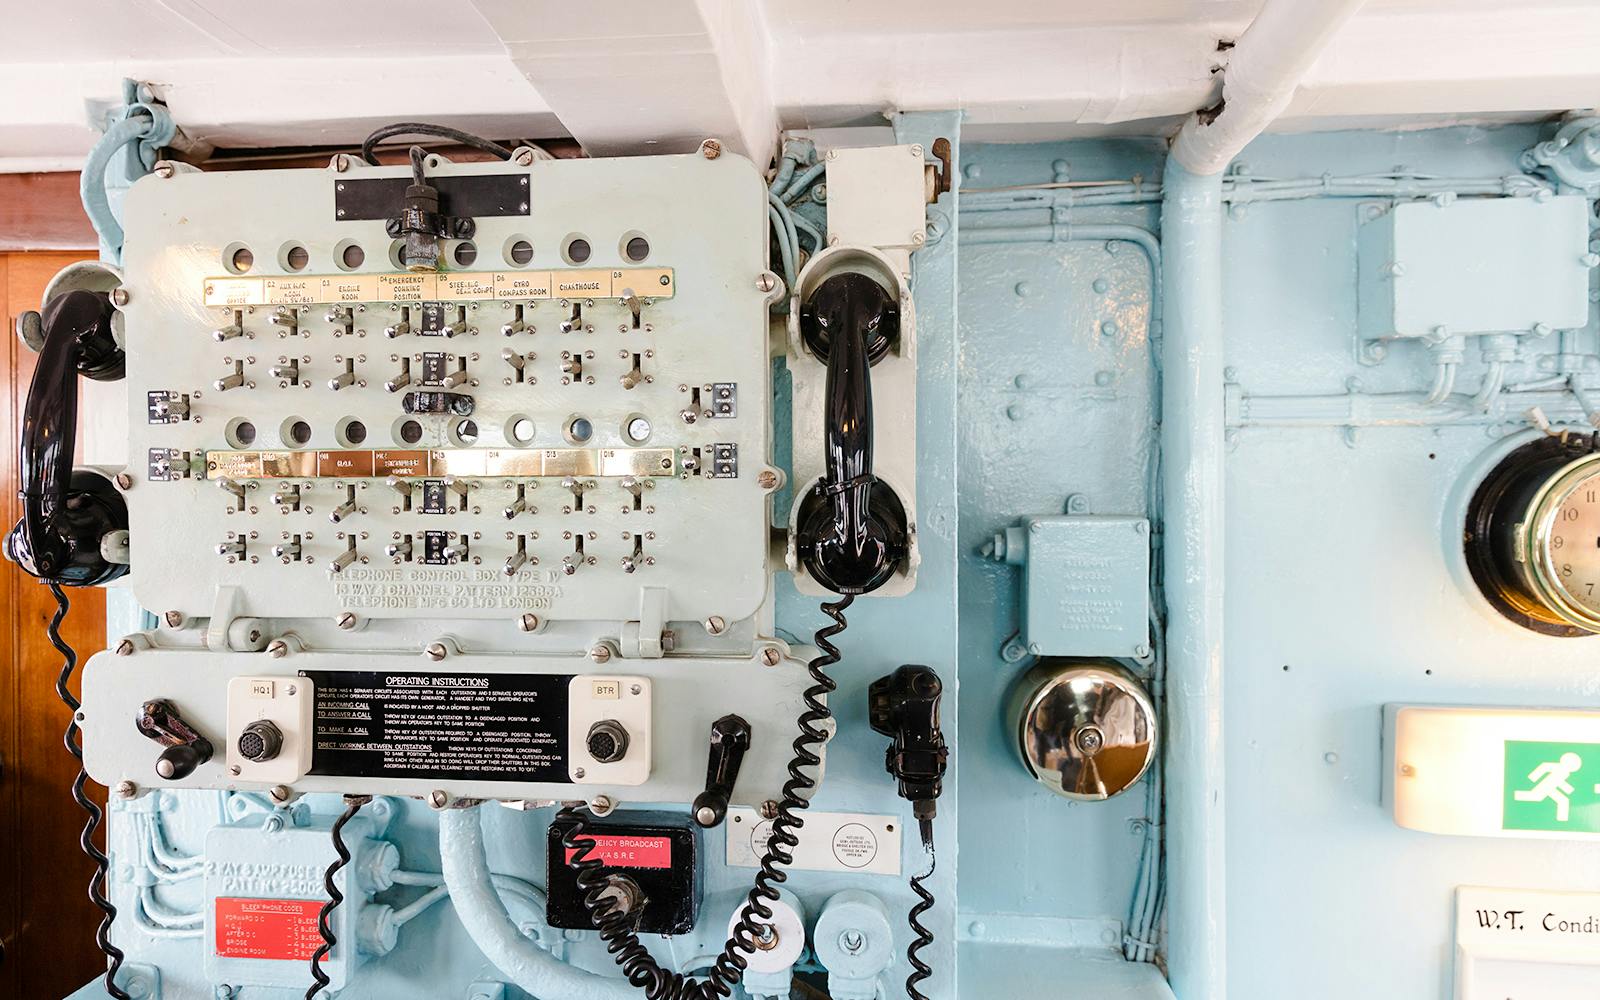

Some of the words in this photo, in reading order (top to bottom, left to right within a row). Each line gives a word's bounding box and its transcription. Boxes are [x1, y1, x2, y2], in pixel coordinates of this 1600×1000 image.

[388, 276, 424, 284] EMERGENCY
[1587, 490, 1595, 503] 11
[1563, 508, 1578, 521] 10
[1554, 536, 1563, 548] 9
[328, 569, 402, 581] TELEPHONE
[410, 570, 469, 581] CONTROL
[474, 570, 500, 581] BOX
[1563, 564, 1572, 576] 8
[352, 584, 376, 595] WAY
[389, 584, 450, 596] CHANNEL
[453, 585, 510, 596] PATTERN
[1586, 583, 1594, 596] 7
[341, 596, 417, 608] TELEPHONE
[420, 597, 446, 608] MFG
[472, 597, 496, 608] LTD
[500, 597, 552, 608] LONDON
[385, 676, 430, 685] OPERATING
[431, 677, 489, 687] INSTRUCTIONS
[620, 840, 663, 848] BROADCAST
[1476, 910, 1524, 930] W.T.
